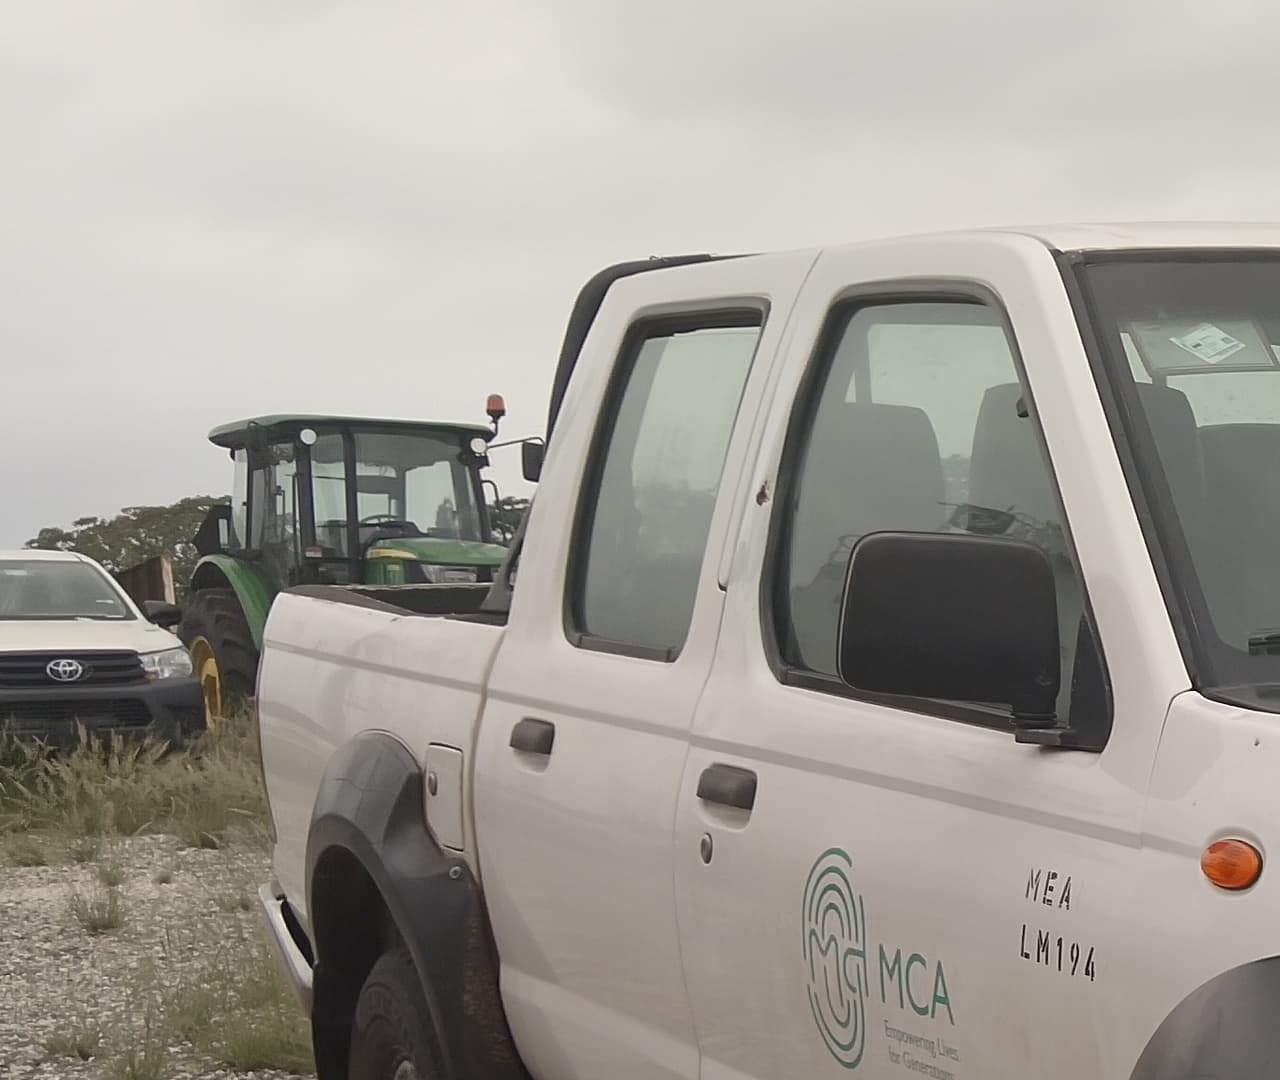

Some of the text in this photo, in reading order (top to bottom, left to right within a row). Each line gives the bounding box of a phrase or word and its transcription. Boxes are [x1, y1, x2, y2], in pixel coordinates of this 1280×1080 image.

[1025, 867, 1073, 911] MEA
[1019, 923, 1097, 982] LM194
[878, 942, 956, 1026] MCA
